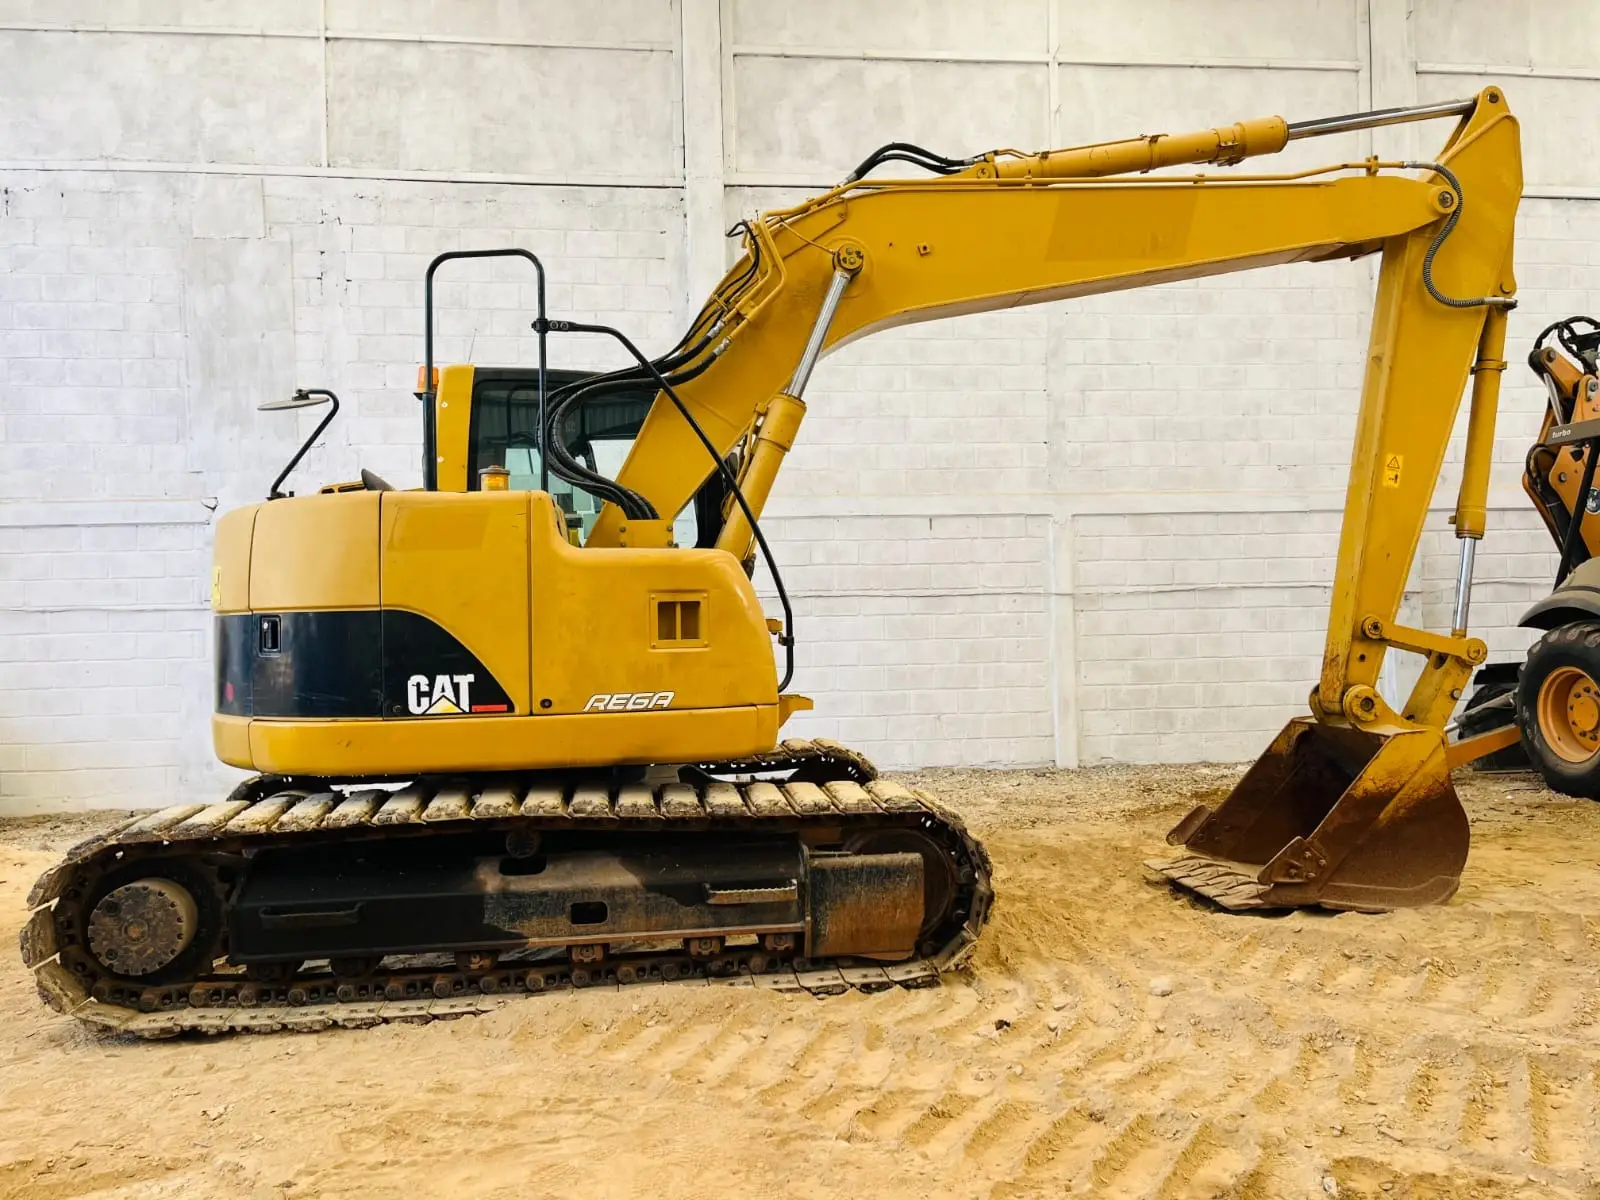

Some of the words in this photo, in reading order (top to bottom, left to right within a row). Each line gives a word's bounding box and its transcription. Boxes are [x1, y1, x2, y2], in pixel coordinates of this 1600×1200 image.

[1552, 429, 1571, 439] turbo
[407, 674, 474, 715] CAT
[583, 691, 675, 712] REGA
